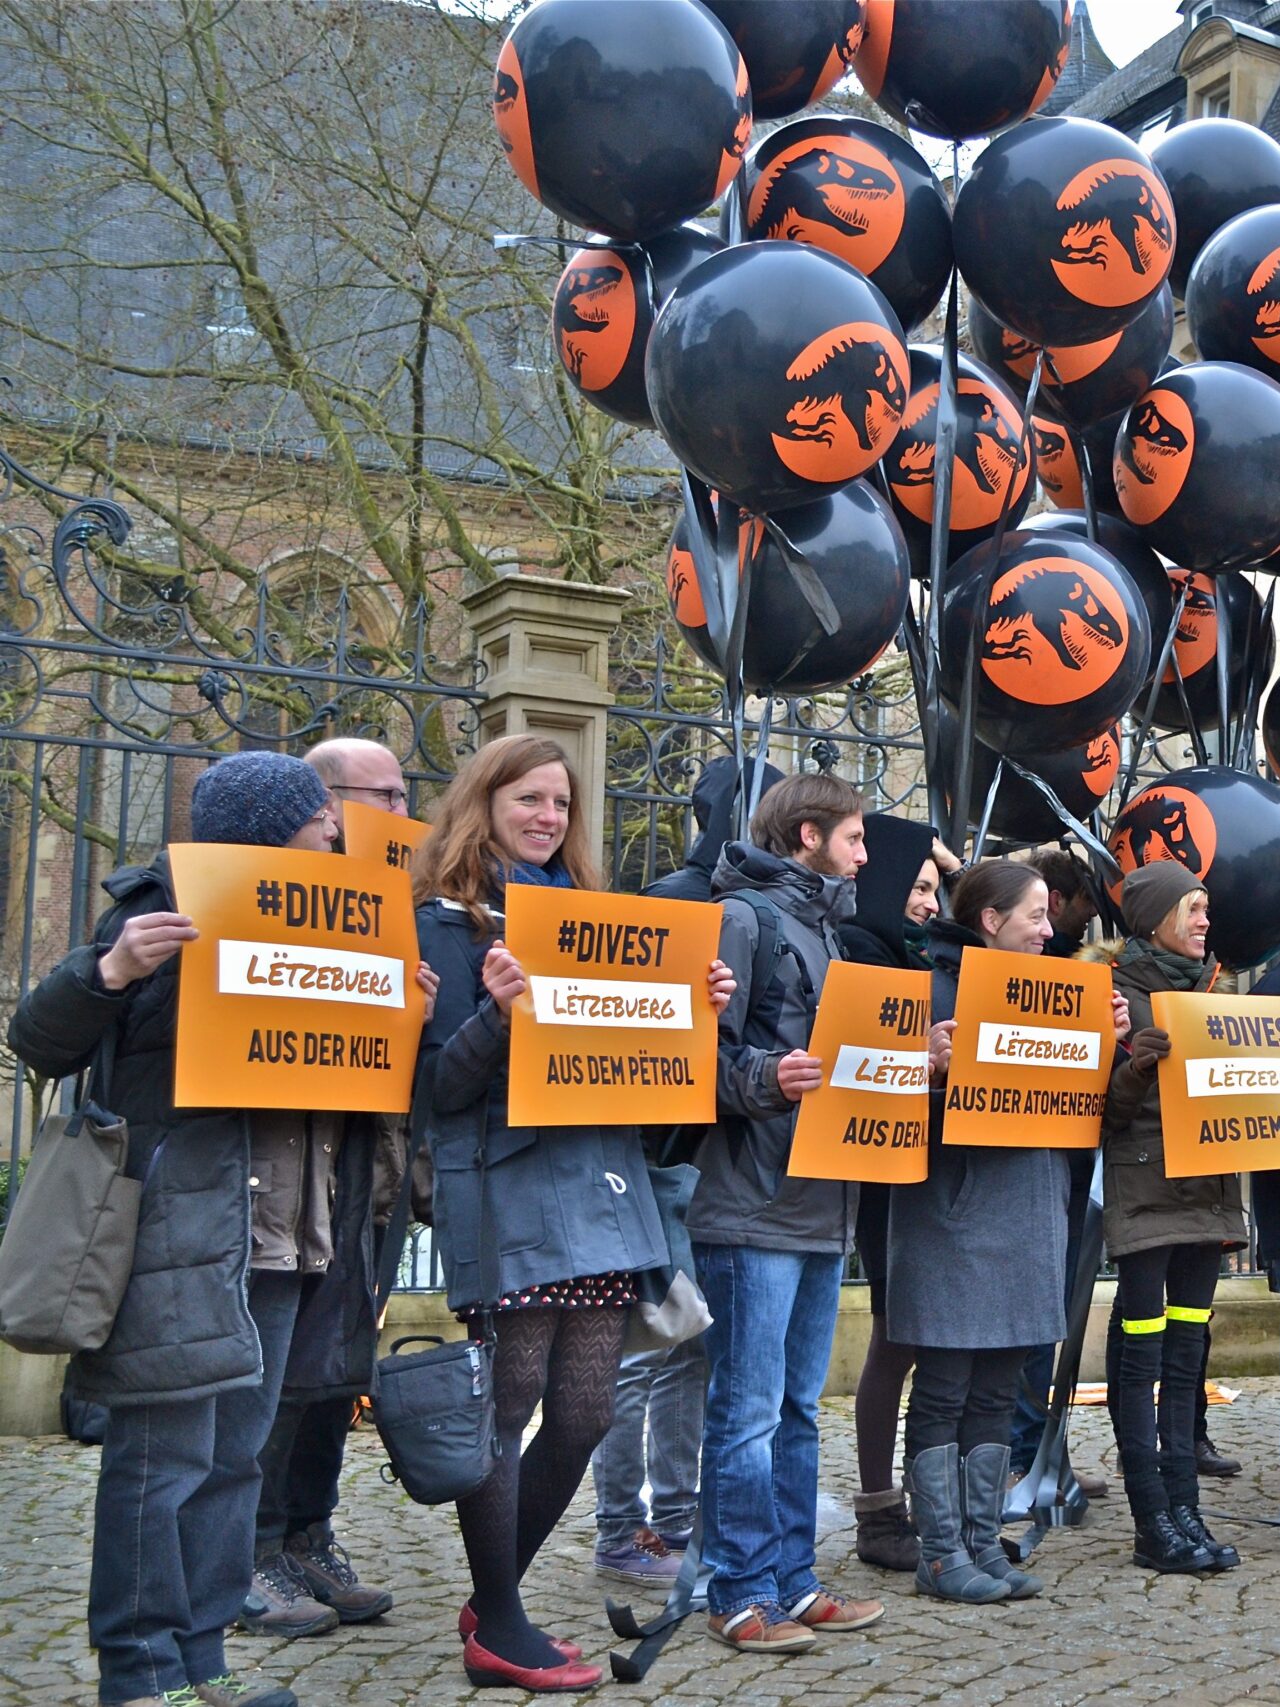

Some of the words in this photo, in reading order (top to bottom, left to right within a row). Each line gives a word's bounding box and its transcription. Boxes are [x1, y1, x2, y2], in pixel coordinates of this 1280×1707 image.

[256, 879, 383, 938] #DIVEST
[557, 920, 670, 967] #DIVEST
[246, 951, 393, 997] LËTZEBUERG
[553, 985, 676, 1020] LËTZEBUERG
[1006, 977, 1085, 1018] #DIVEST
[247, 1028, 298, 1065] AUS
[303, 1032, 345, 1067] DER
[349, 1035, 392, 1070] KUEL
[994, 1030, 1089, 1061] LËTZEBUERG
[546, 1054, 583, 1085] AUS
[589, 1055, 625, 1086] DEM
[629, 1049, 695, 1086] PËTROL
[947, 1085, 987, 1112] AUS
[990, 1088, 1021, 1114] DER
[1023, 1089, 1107, 1117] ATOMENERGIE
[842, 1117, 889, 1146] AUS
[891, 1121, 920, 1148] DER
[1199, 1118, 1241, 1144] AUS
